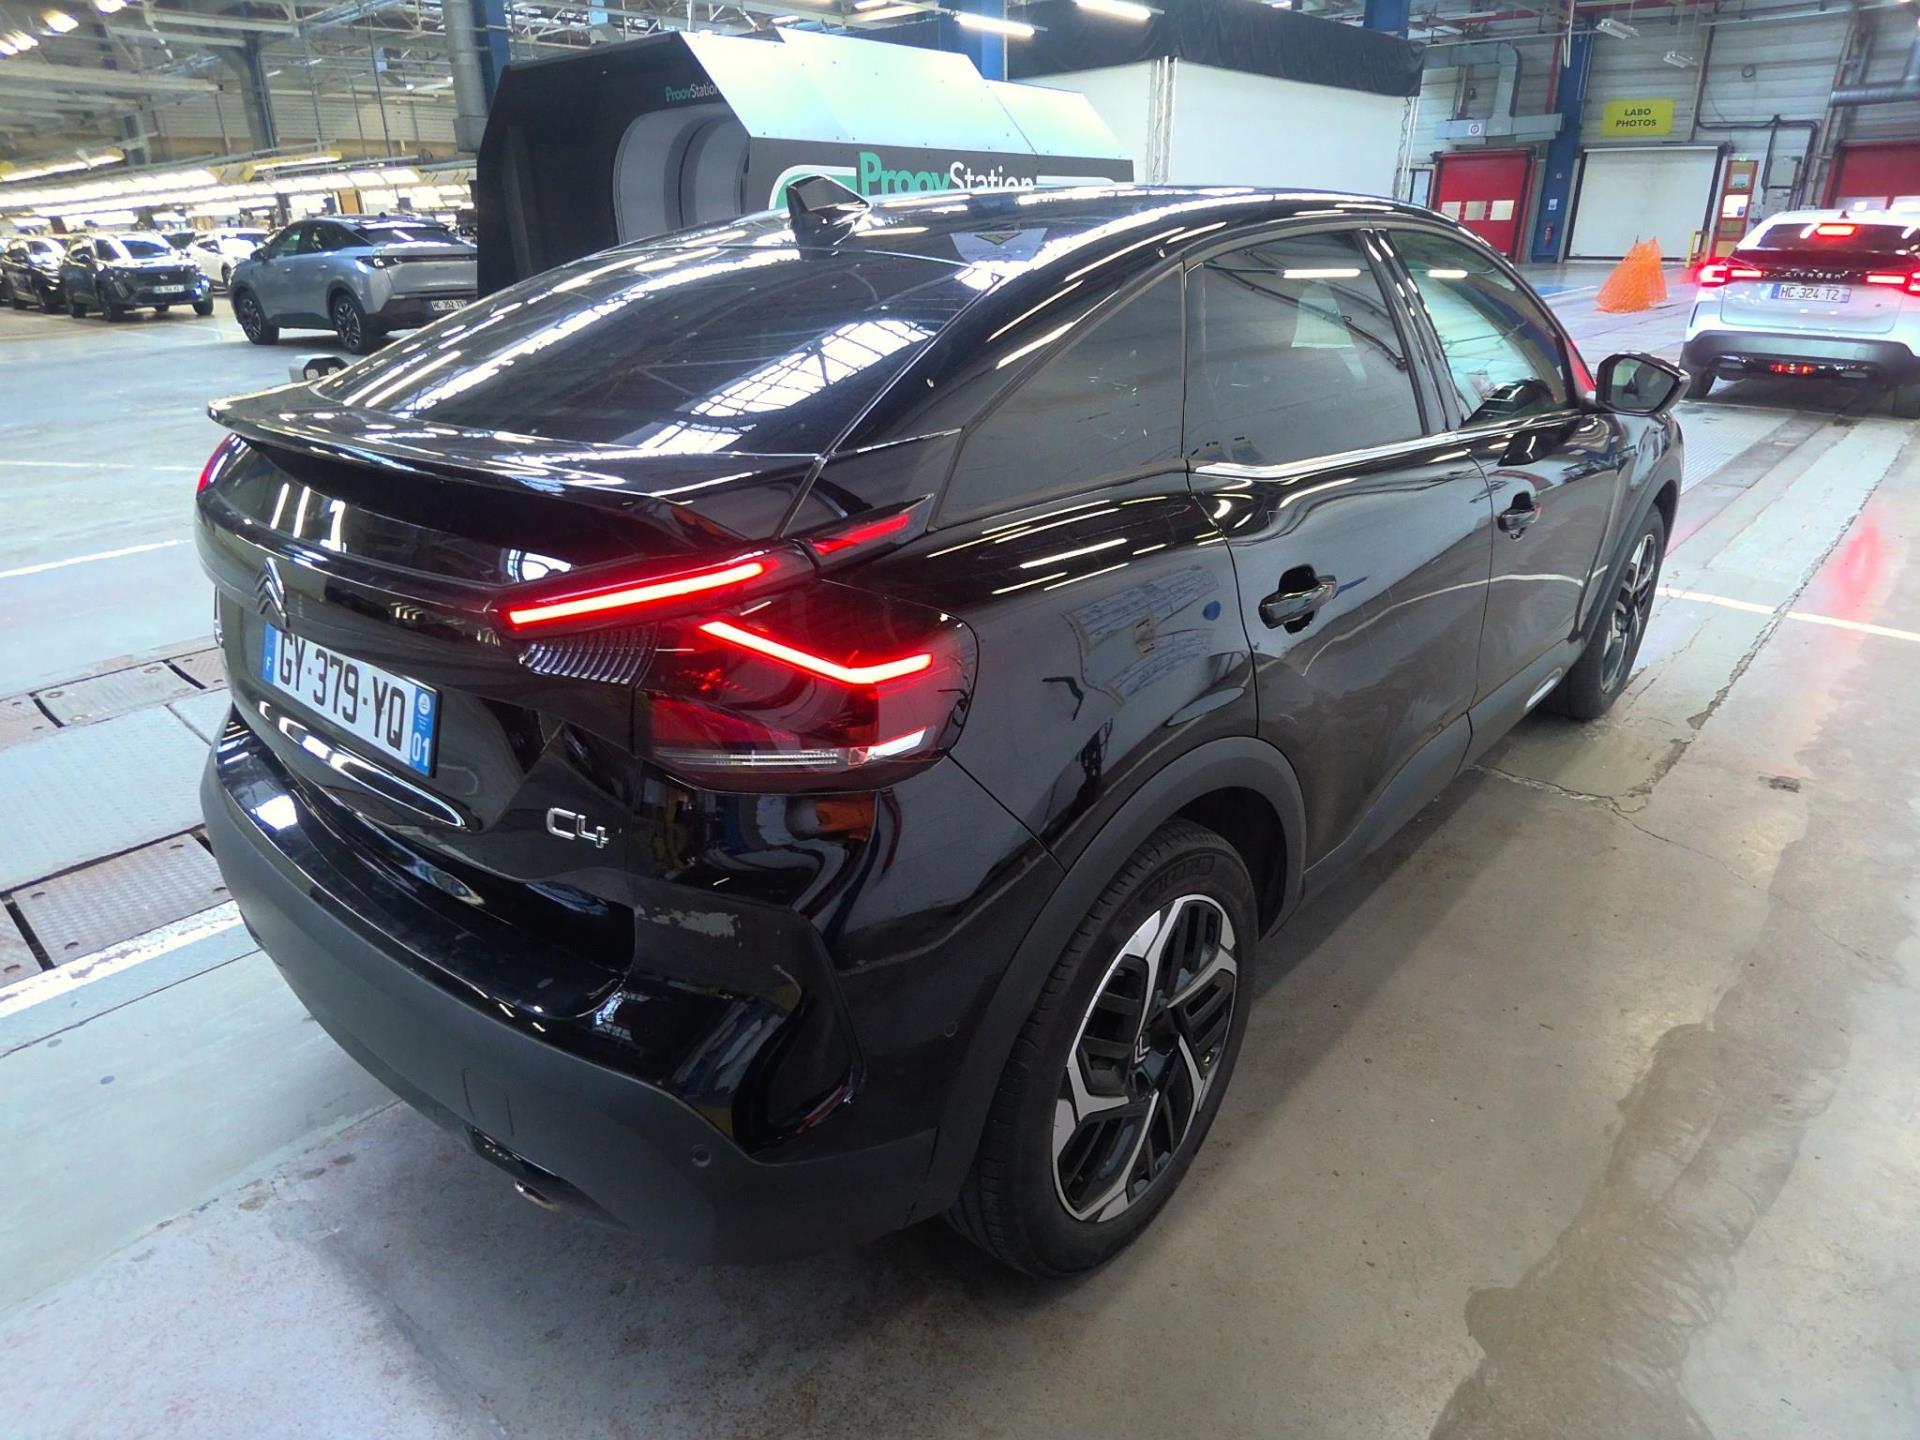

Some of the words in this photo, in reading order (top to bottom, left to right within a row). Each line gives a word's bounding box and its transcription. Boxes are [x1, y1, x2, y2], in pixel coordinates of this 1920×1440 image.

[1616, 119, 1657, 128] PHOTOS
[1624, 108, 1652, 117] LABO
[279, 632, 406, 752] GY-379-YQ
[411, 732, 431, 767] 01
[546, 807, 609, 849] C4
